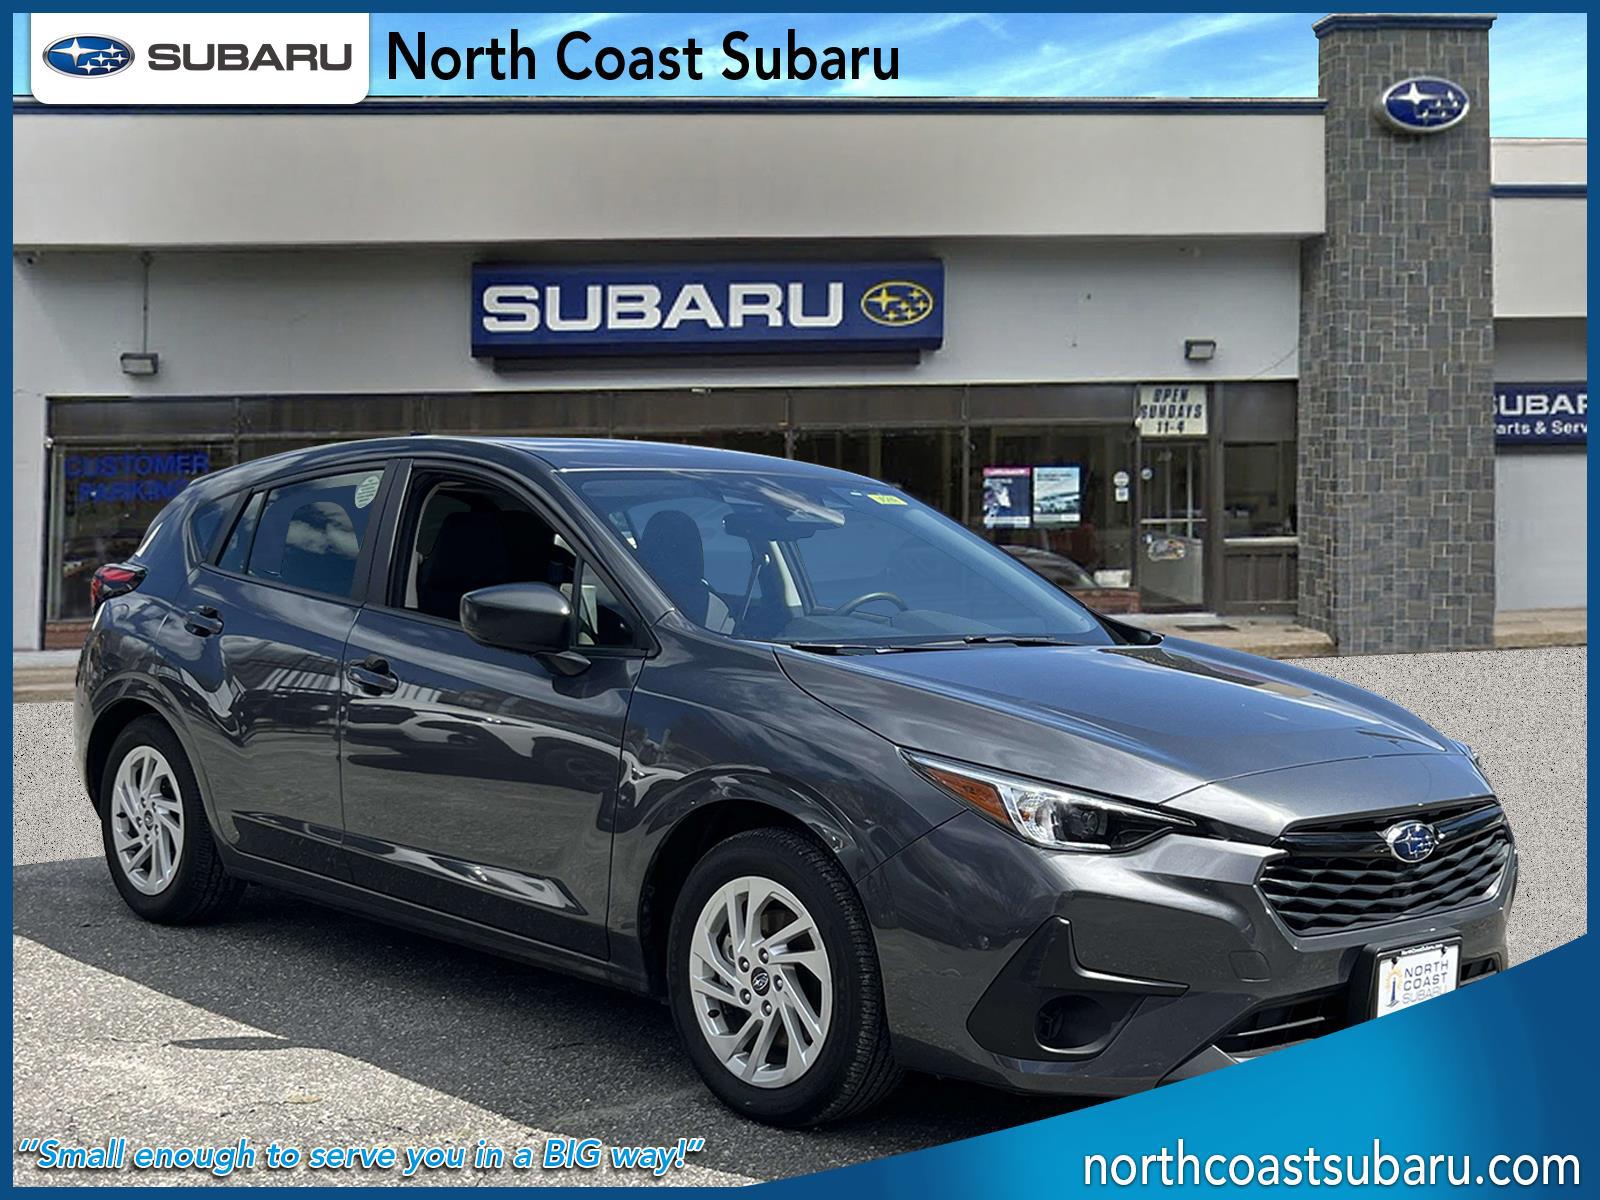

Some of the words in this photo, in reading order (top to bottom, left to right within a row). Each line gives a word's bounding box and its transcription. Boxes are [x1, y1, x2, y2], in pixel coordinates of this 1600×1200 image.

[482, 282, 843, 331] SUBARU
[1153, 387, 1189, 402] OPEN
[1140, 403, 1202, 419] SUNDAYS
[1493, 394, 1587, 415] UBA
[1157, 421, 1185, 432] 11-4
[1495, 421, 1531, 435] arts
[1534, 420, 1546, 435] &
[65, 451, 209, 477] CUSTOMER
[1404, 961, 1448, 978] NORTH
[1403, 972, 1447, 992] COAST
